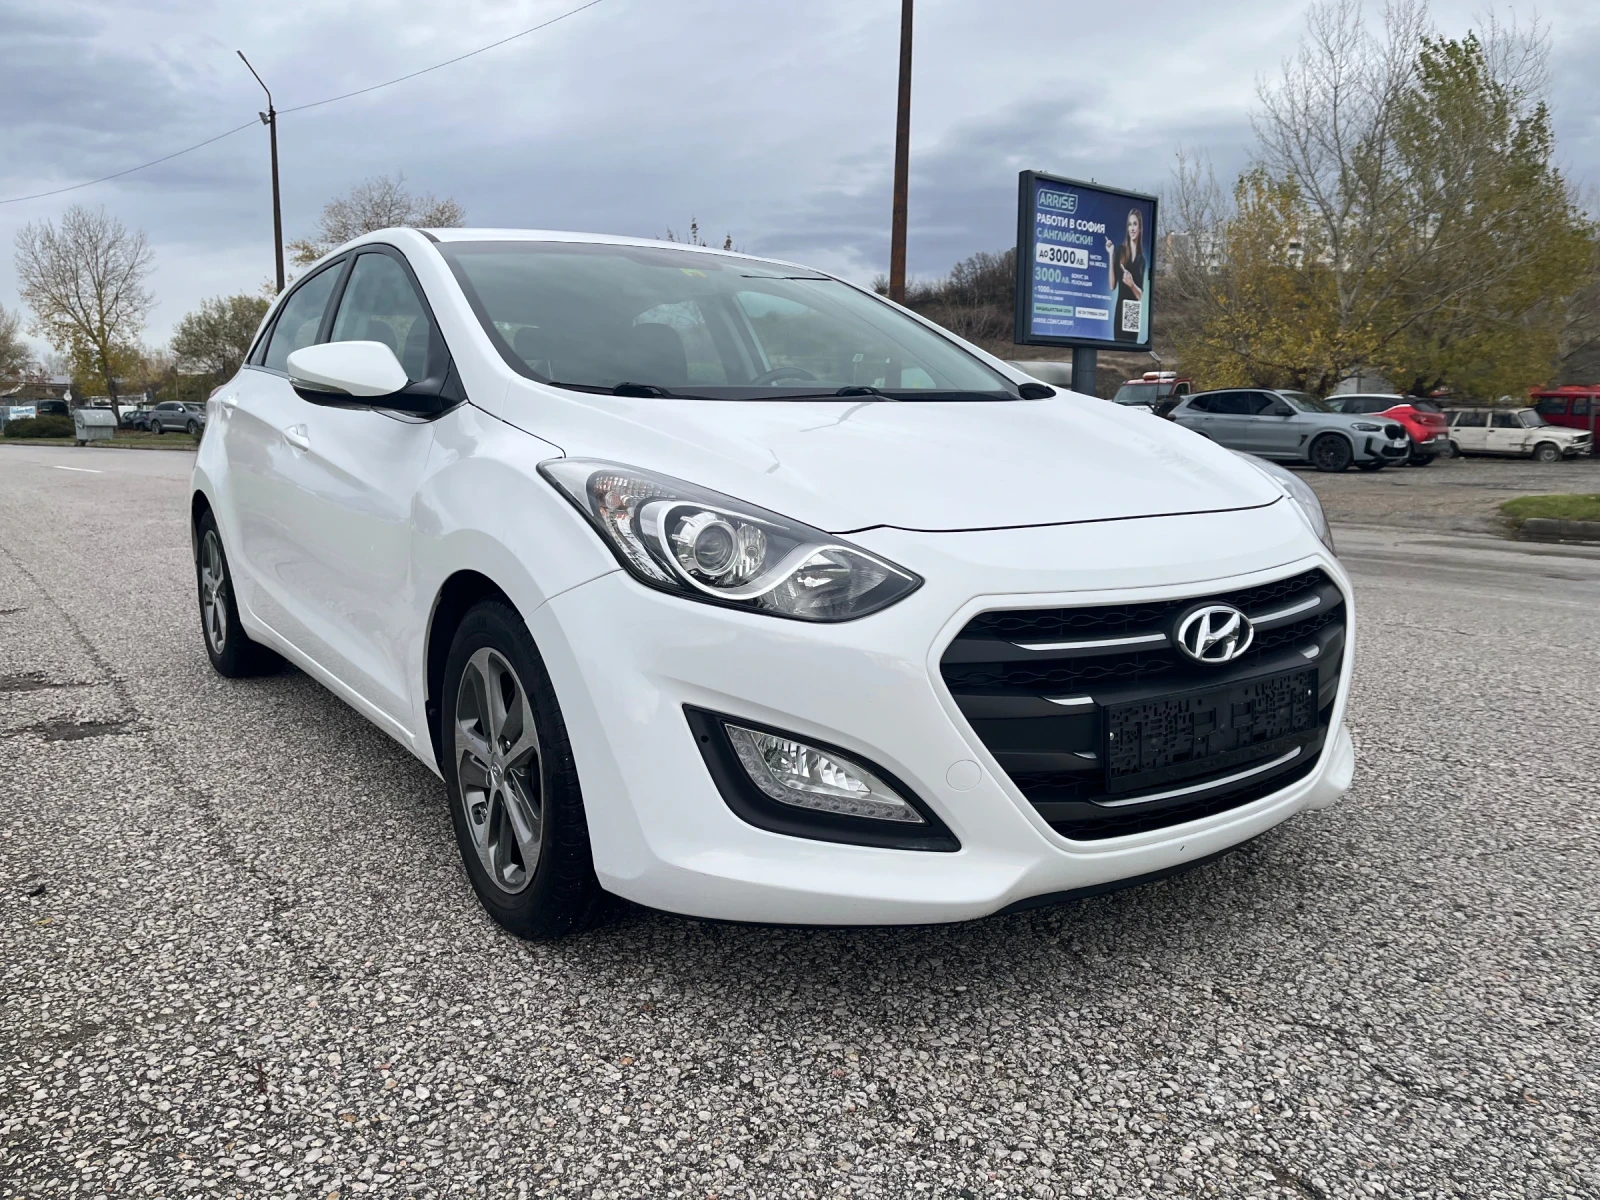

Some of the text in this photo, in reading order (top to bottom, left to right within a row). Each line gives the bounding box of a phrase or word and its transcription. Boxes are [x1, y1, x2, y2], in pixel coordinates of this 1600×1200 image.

[1039, 192, 1075, 210] ARRISE
[1037, 213, 1106, 234] РАБОТИ В СОФИЯ
[1037, 228, 1093, 245] С АНГЛИЙСКИ!
[1049, 248, 1076, 264] 3000
[1035, 268, 1061, 282] 3000
